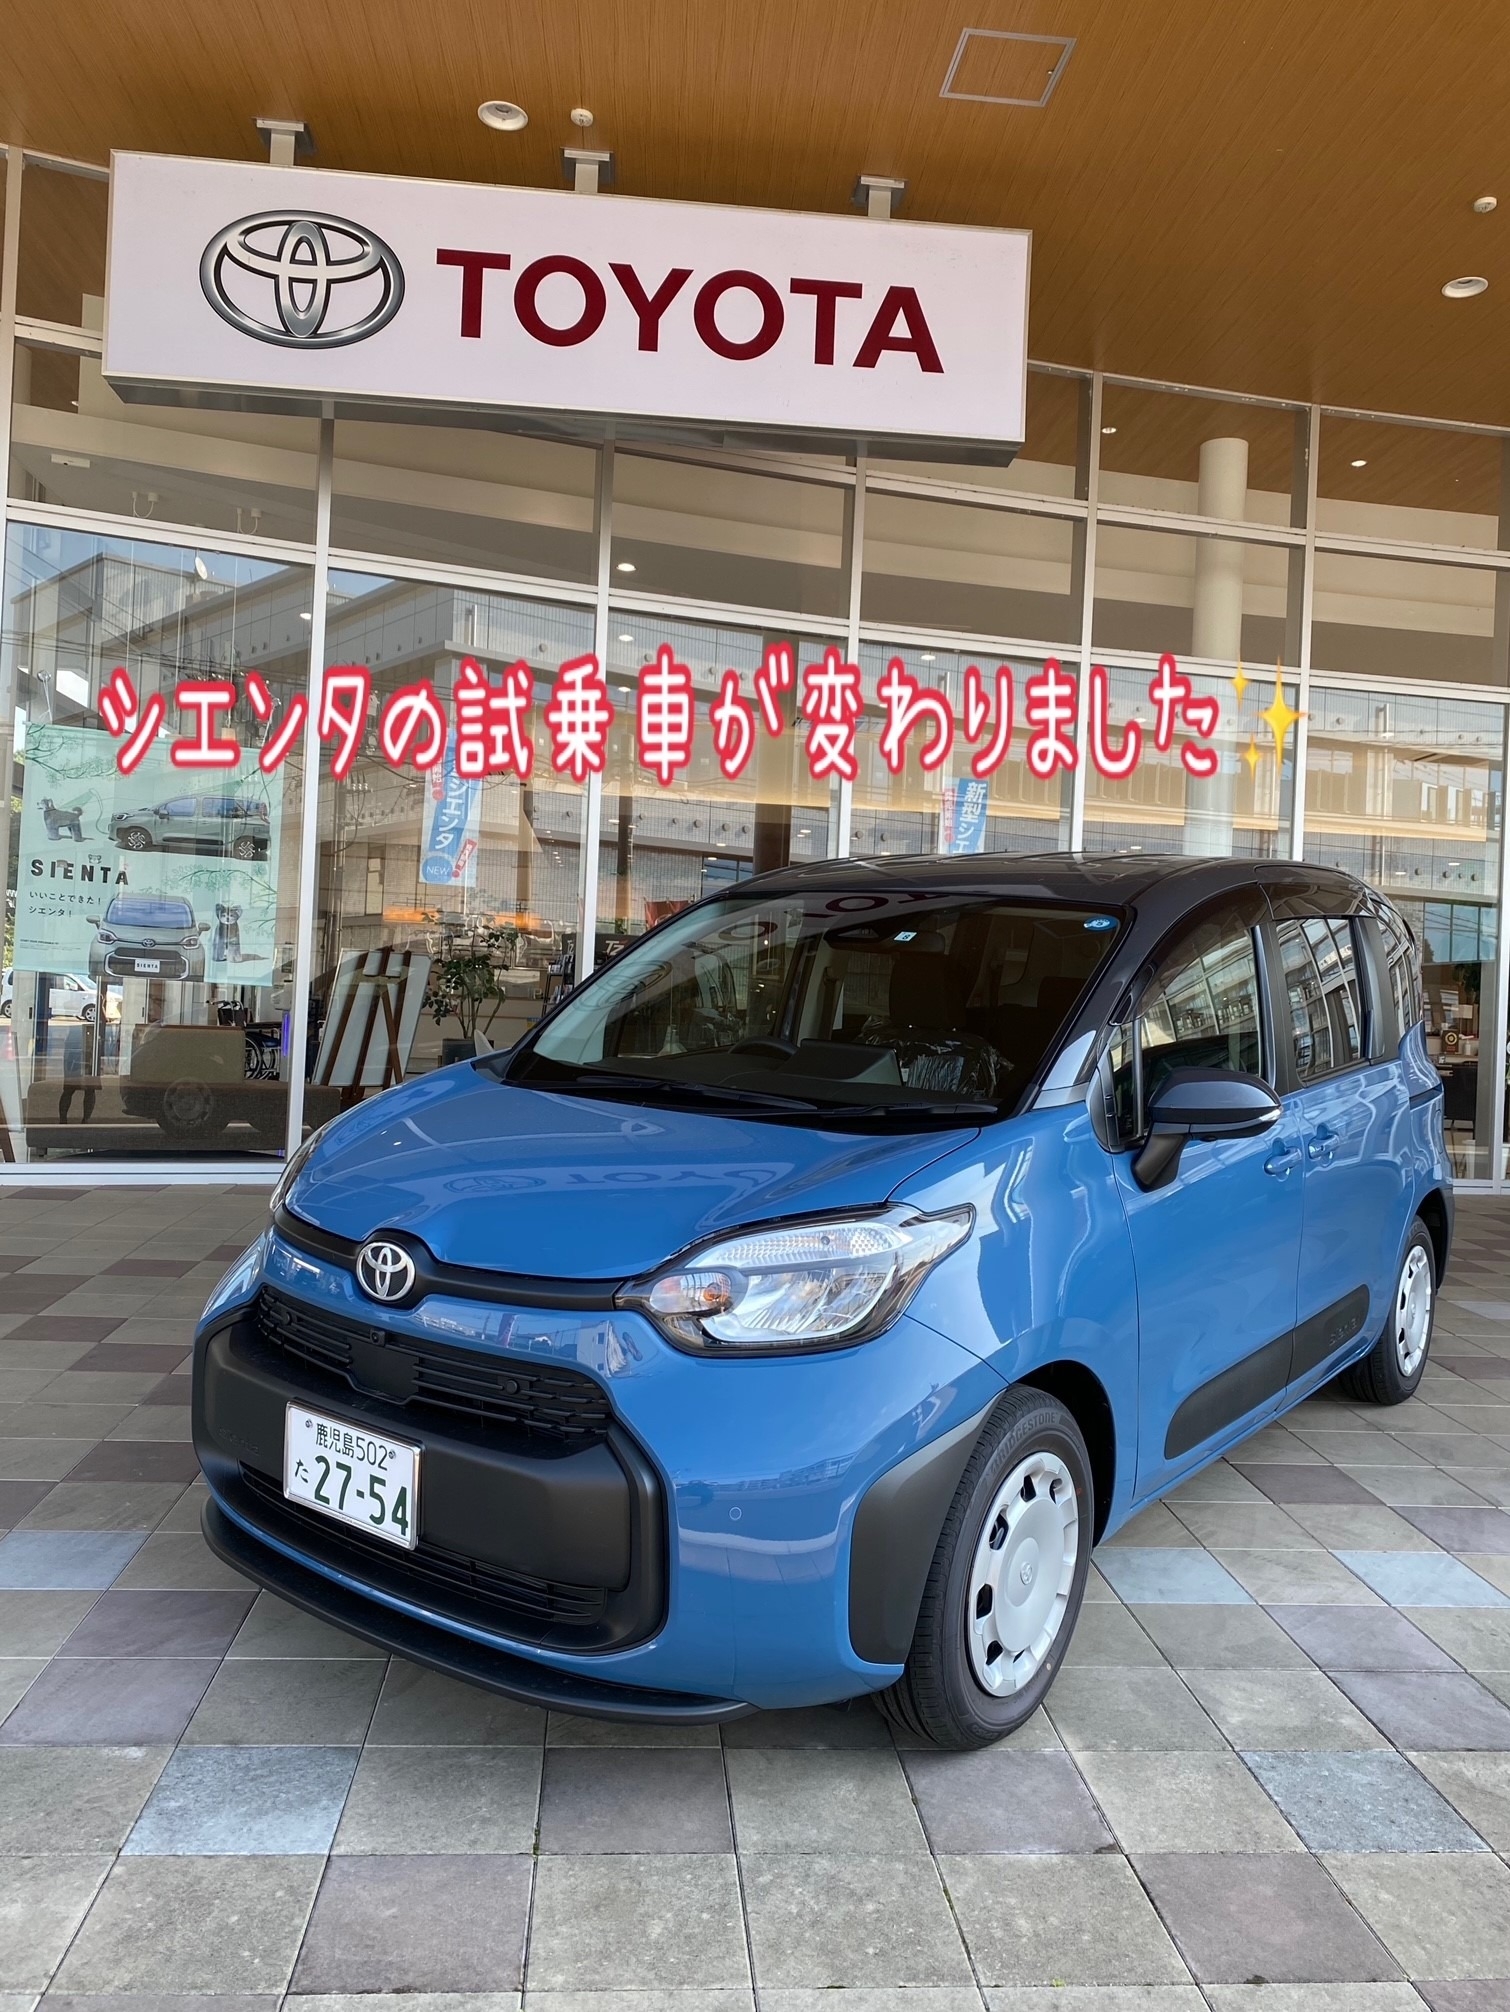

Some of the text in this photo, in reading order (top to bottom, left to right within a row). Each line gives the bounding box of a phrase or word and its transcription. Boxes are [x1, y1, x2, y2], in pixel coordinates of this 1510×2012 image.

[437, 248, 944, 374] TOYOTA
[435, 776, 468, 849] シエンタ
[31, 859, 128, 885] SIENTA
[426, 865, 450, 875] NEW
[29, 891, 101, 906] いいことできた!
[29, 905, 72, 918] シエンタ!
[295, 1455, 409, 1536] た 27-54
